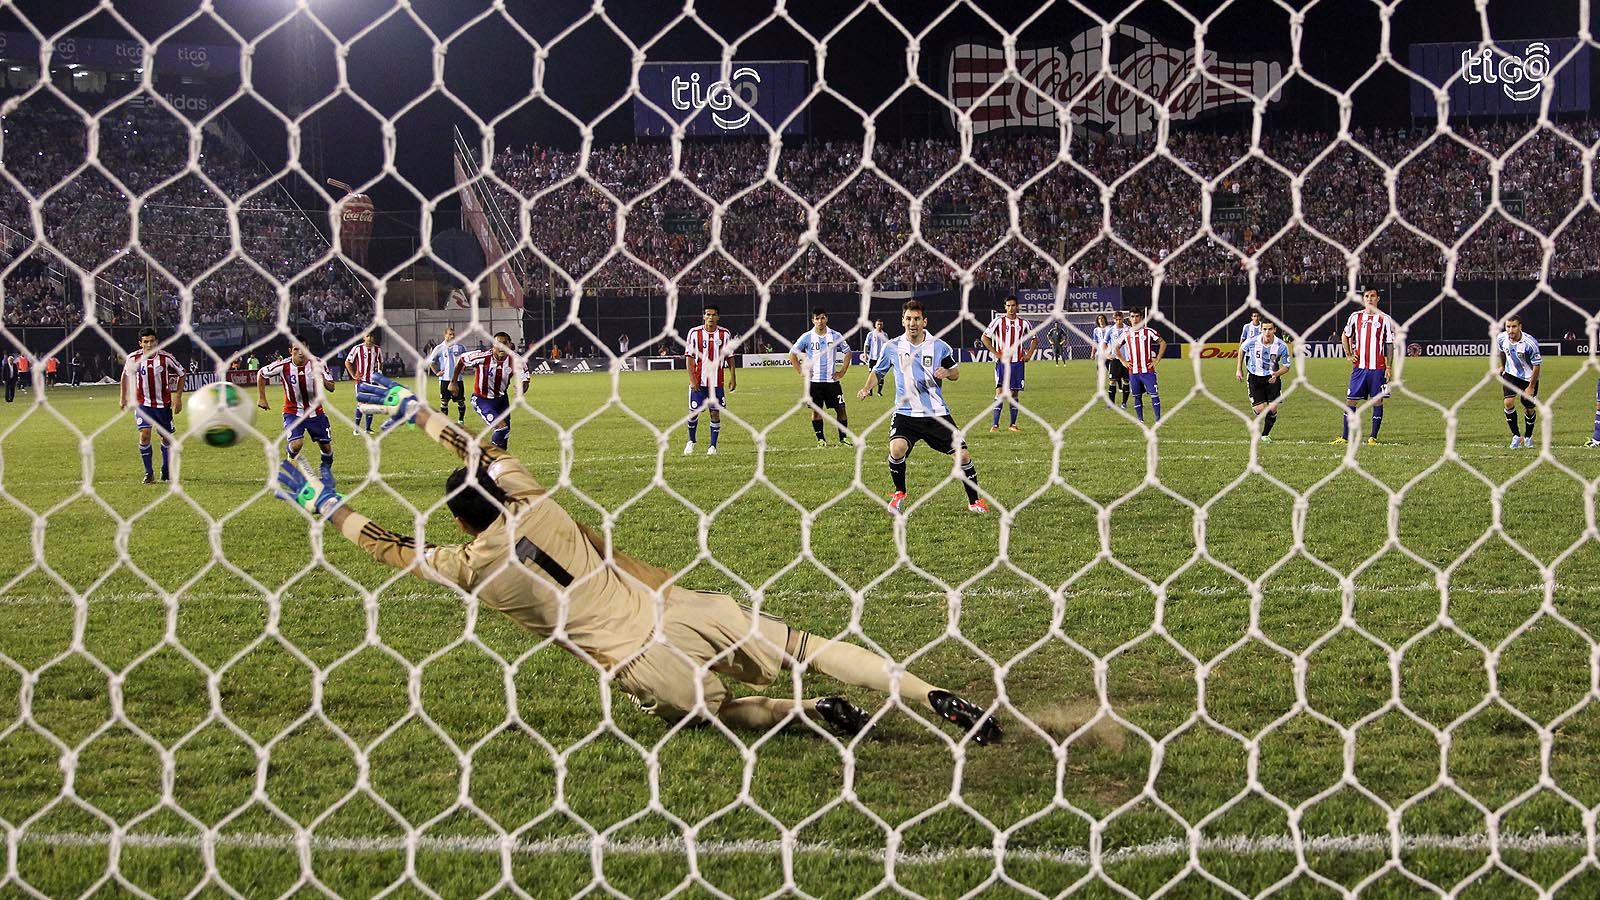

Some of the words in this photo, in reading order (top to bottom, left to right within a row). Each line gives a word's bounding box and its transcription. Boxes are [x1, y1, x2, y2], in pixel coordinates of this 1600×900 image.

[177, 46, 208, 61] tigo
[1461, 43, 1550, 84] tigo
[671, 68, 761, 110] tigo
[143, 95, 208, 111] adidas
[1069, 291, 1098, 300] NORTE
[1017, 302, 1056, 313] EDRO
[1070, 301, 1114, 313] ARCIA
[811, 341, 821, 351] 20
[1303, 343, 1345, 358] SAM
[1426, 344, 1490, 356] CONMEBOL
[969, 349, 999, 361] VIS
[1255, 350, 1261, 359] 5
[183, 373, 219, 392] SAMSU
[515, 535, 576, 588] 1
